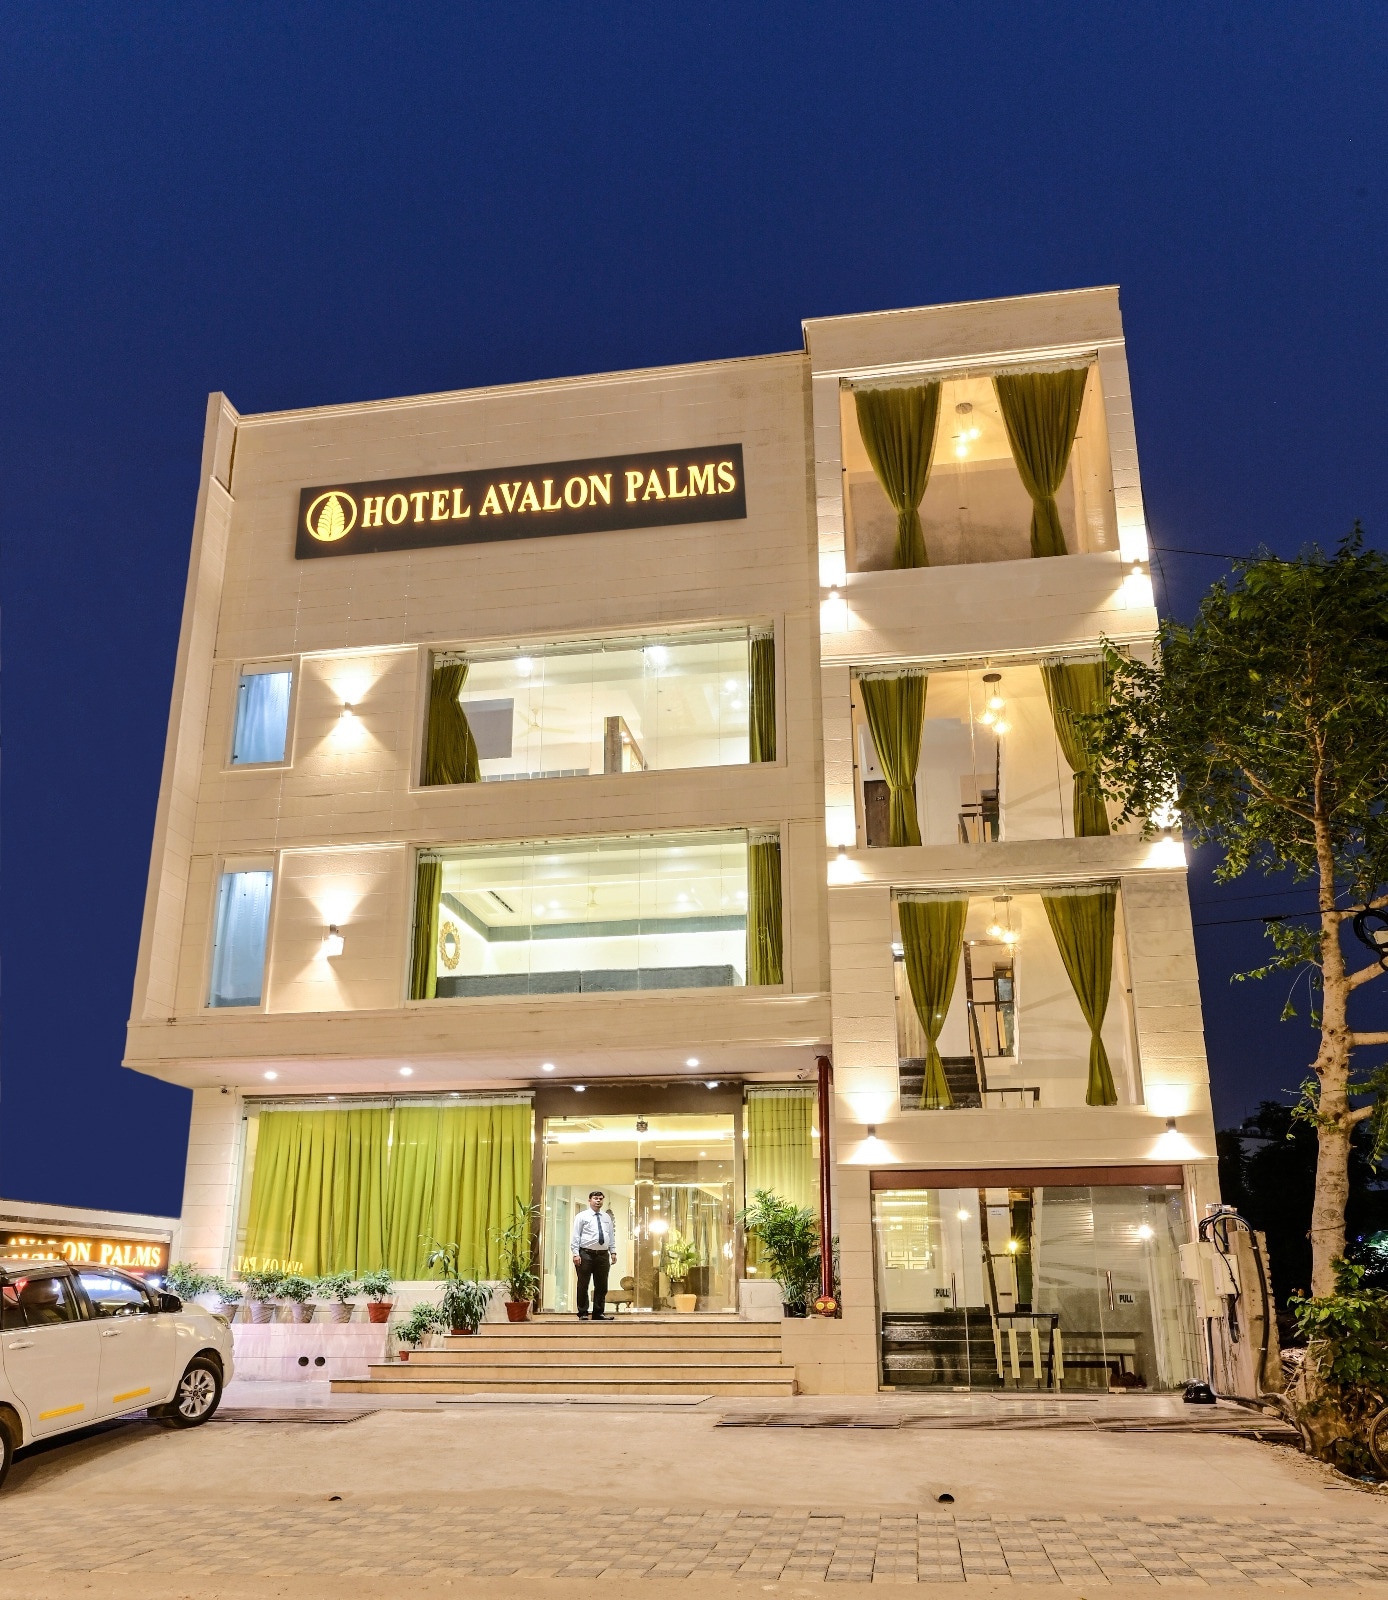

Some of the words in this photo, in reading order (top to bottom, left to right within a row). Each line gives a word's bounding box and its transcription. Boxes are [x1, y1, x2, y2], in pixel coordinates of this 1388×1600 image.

[361, 488, 471, 528] HOTEL
[479, 473, 612, 516] AVALON
[624, 461, 736, 502] PALMS
[100, 1243, 161, 1267] PALMS
[935, 1288, 950, 1298] PULL
[1119, 1294, 1134, 1304] PULL
